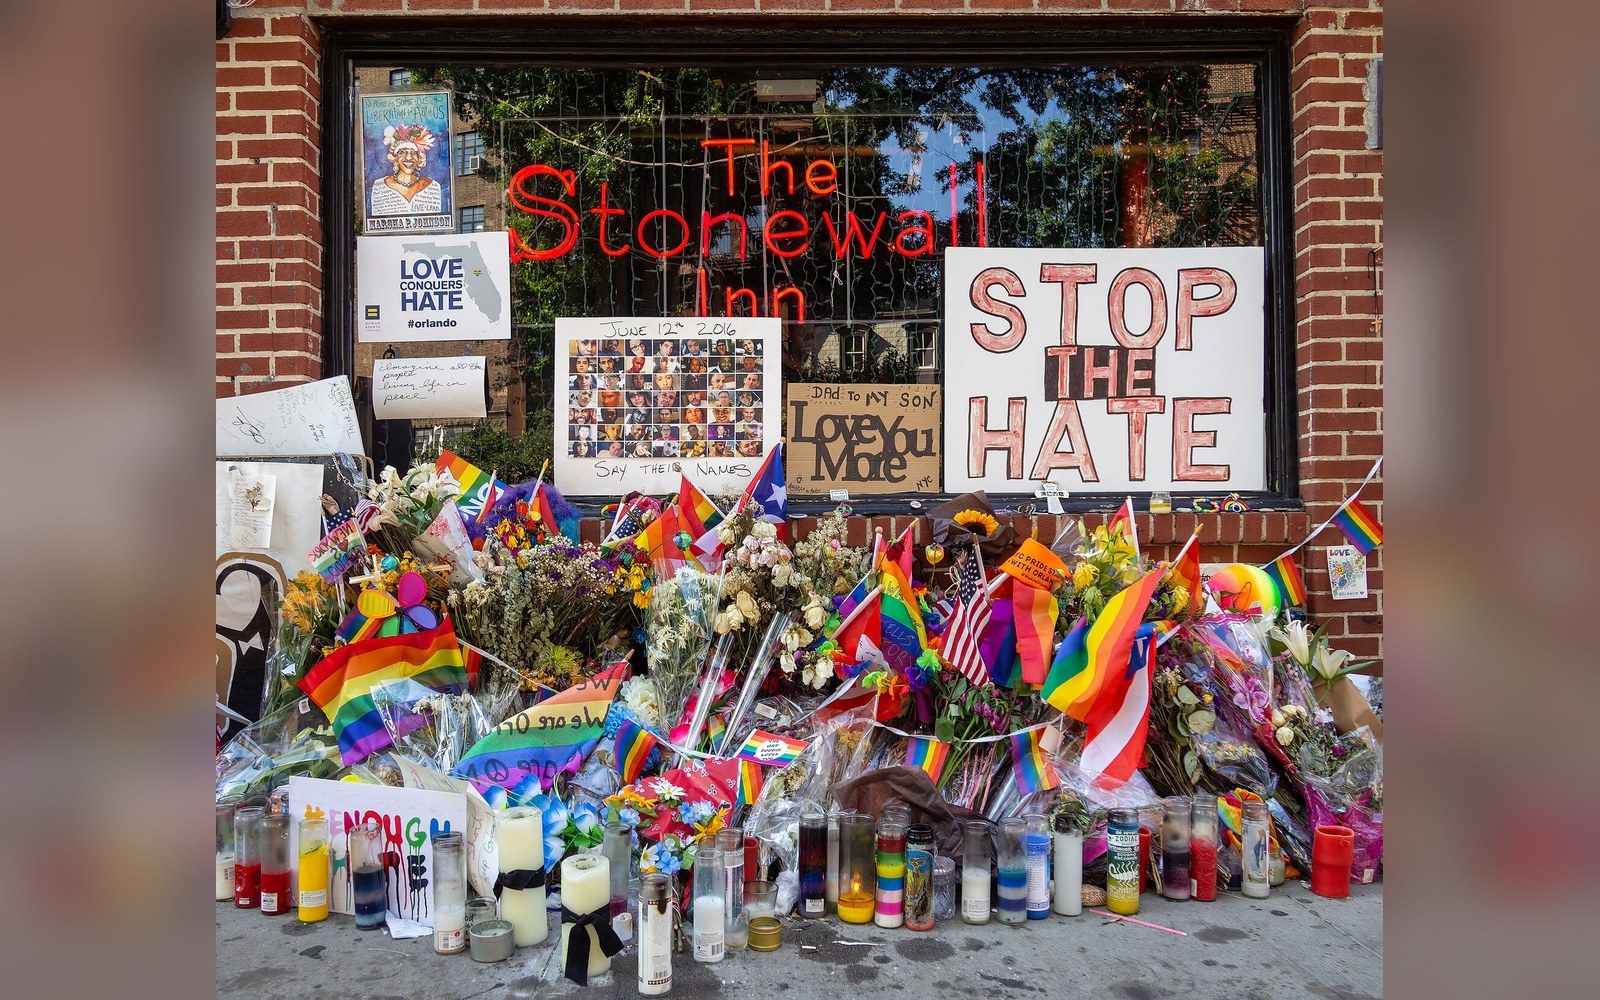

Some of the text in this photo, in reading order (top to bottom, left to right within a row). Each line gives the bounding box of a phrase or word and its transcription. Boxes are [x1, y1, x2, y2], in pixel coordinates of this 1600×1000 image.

[701, 138, 838, 197] The
[508, 161, 987, 263] Stonewall
[369, 218, 404, 230] MARSHA
[413, 216, 451, 228] JOHNSON
[401, 259, 463, 279] LOVE
[400, 280, 463, 291] CONQUERS
[697, 266, 806, 319] Inn
[401, 291, 463, 312] HATE
[969, 263, 1237, 354] STOP
[408, 319, 457, 329] #orlando
[600, 321, 737, 338] JUNE 12th 2016
[1047, 347, 1154, 399] THE
[866, 390, 889, 407] MY
[899, 390, 937, 410] SON
[790, 400, 937, 458] Love You
[968, 396, 1232, 482] HATE
[594, 461, 752, 482] SAY THEI NAMES
[811, 440, 907, 483] More
[916, 475, 934, 491] NYC
[1329, 548, 1350, 556] LOVE
[1011, 559, 1031, 573] WITH
[1025, 556, 1048, 572] PRIDE
